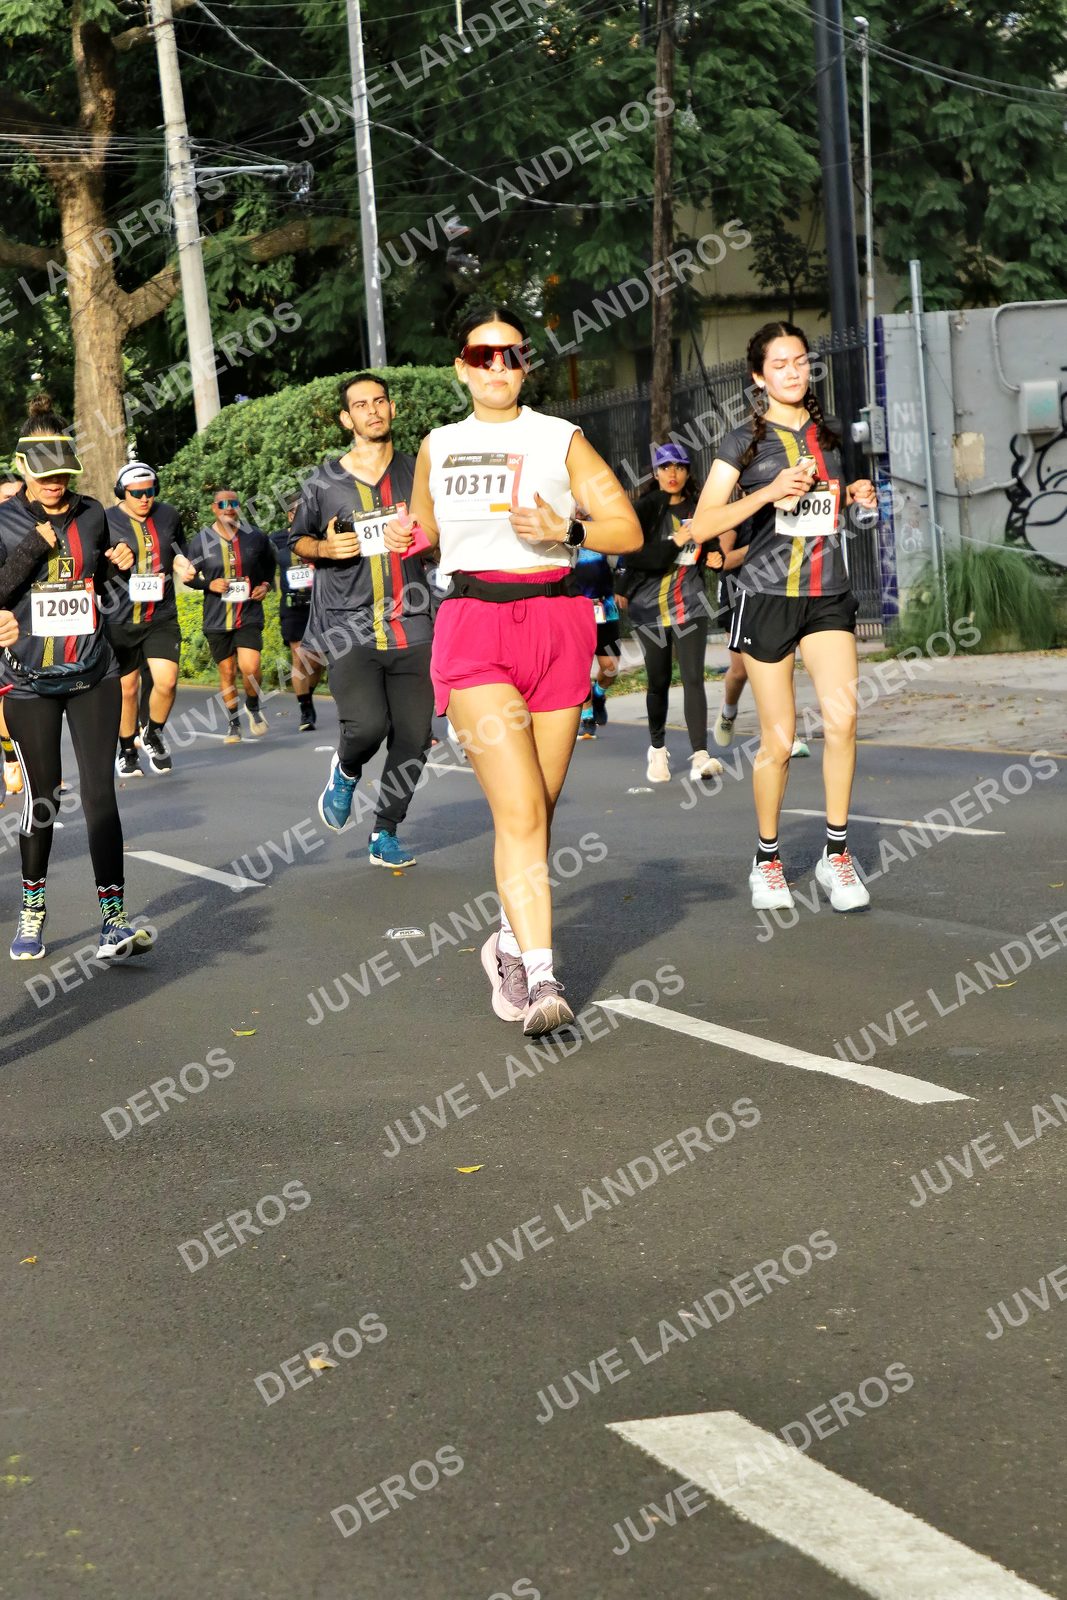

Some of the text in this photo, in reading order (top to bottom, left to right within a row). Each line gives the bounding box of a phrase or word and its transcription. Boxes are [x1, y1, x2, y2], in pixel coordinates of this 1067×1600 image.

[445, 474, 506, 495] 10311
[135, 581, 158, 590] 9224
[36, 598, 89, 617] 12090
